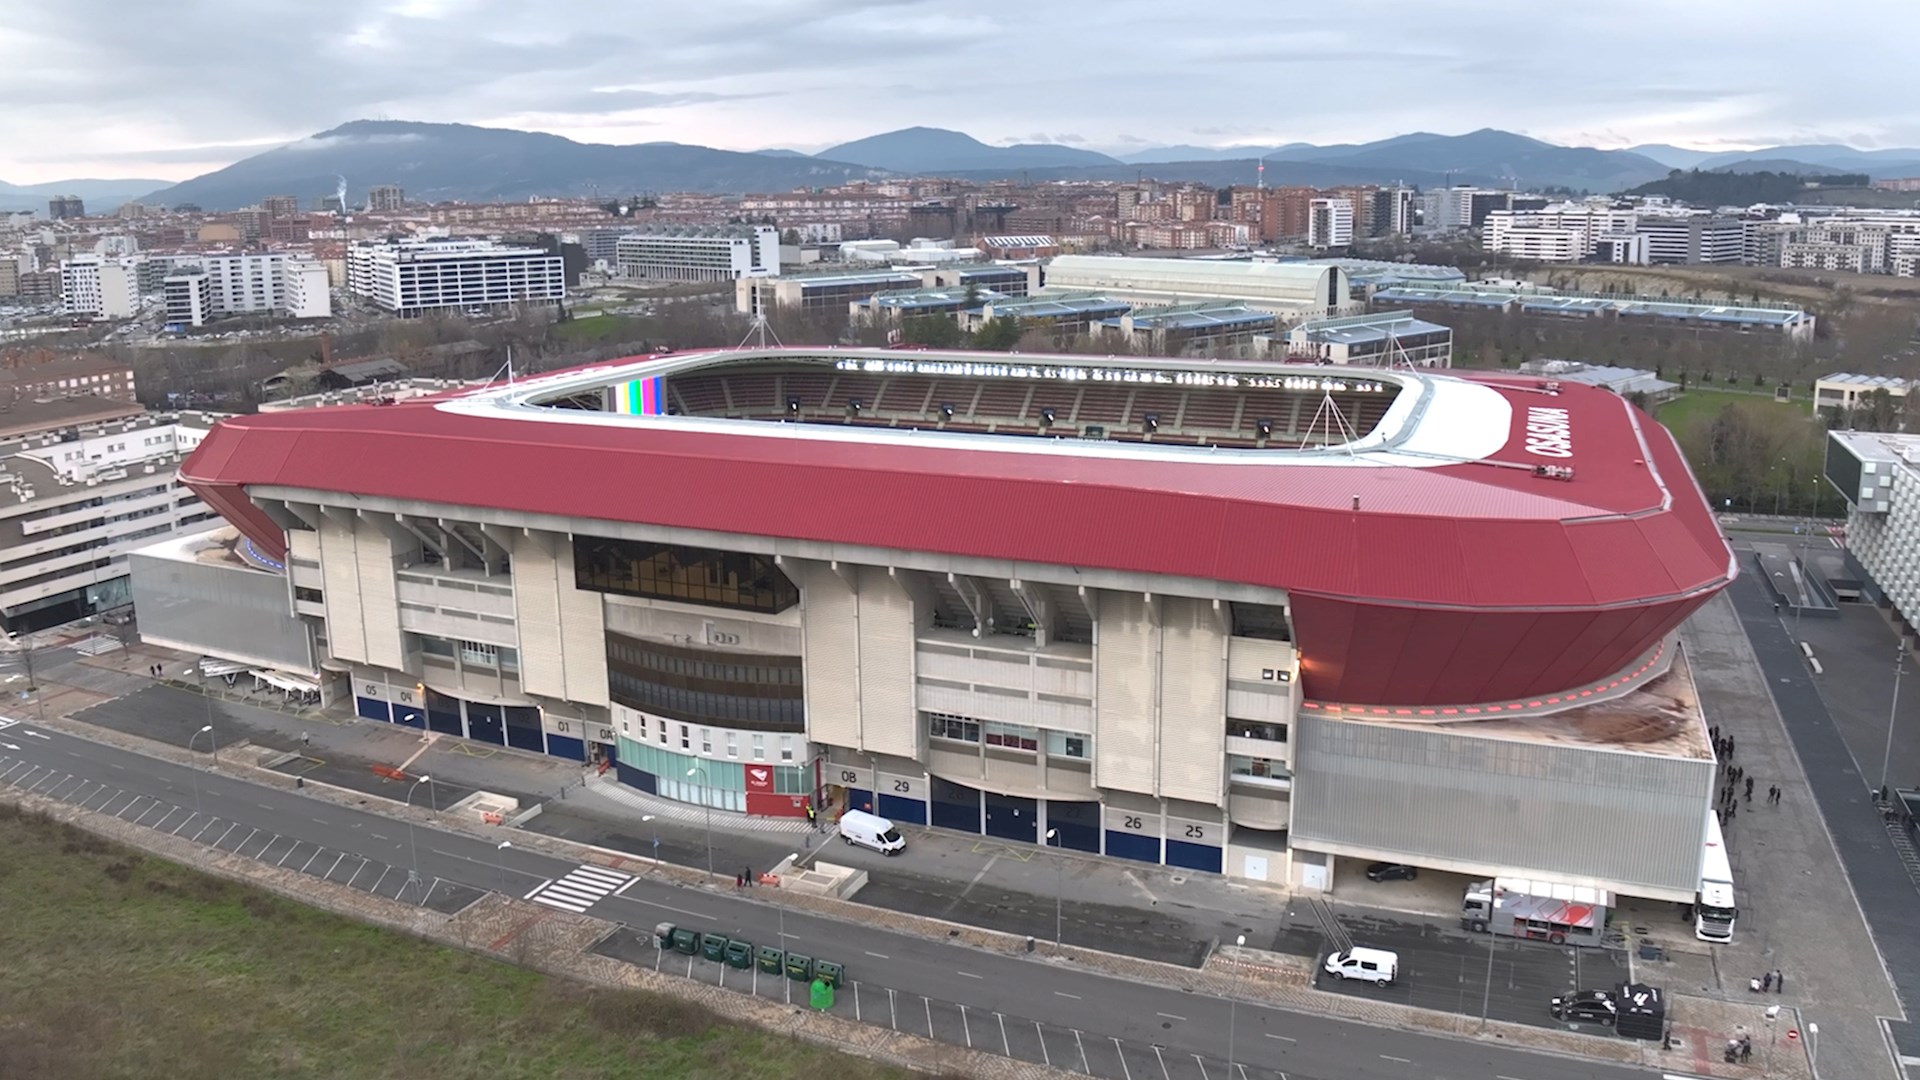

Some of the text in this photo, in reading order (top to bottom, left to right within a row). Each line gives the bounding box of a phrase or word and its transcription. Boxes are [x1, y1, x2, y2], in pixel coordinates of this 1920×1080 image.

[1525, 406, 1573, 458] OSASUNA
[365, 684, 377, 696] 05
[400, 691, 412, 703] 04
[558, 721, 570, 733] 01
[894, 779, 910, 793] 29
[1124, 815, 1143, 830] 26
[1185, 824, 1204, 839] 25
